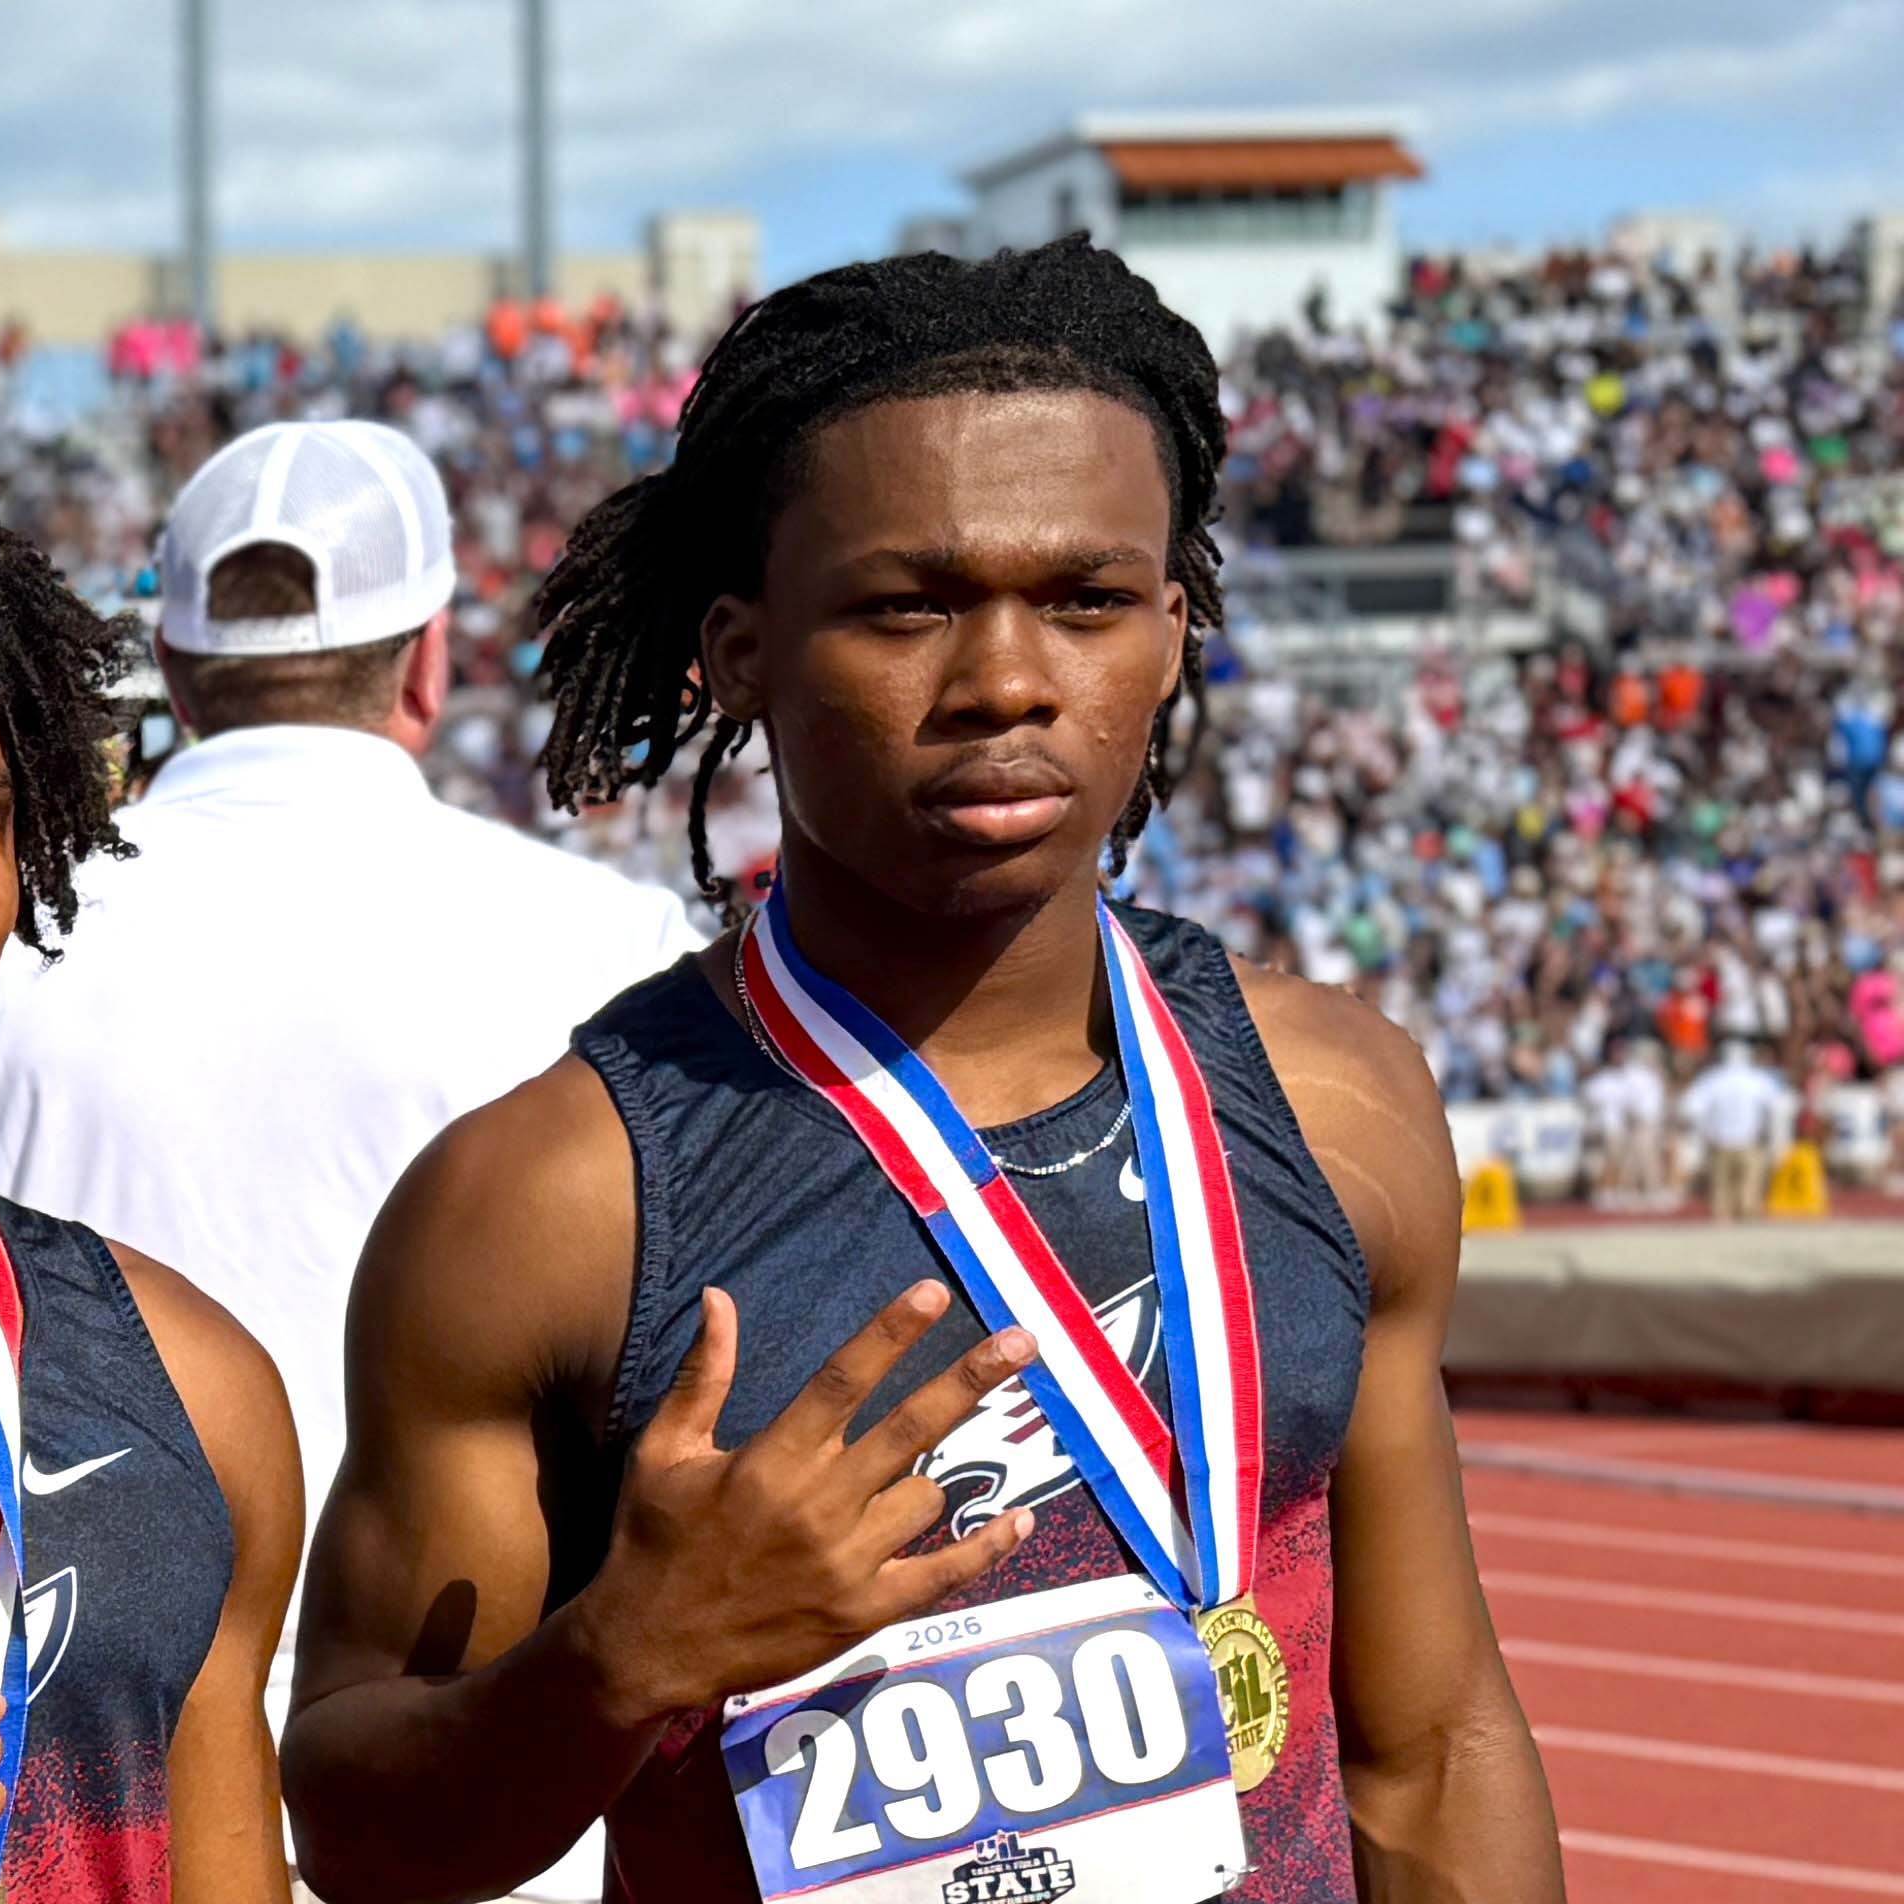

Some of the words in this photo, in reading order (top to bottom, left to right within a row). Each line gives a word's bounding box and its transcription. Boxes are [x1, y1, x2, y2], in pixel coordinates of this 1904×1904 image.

[905, 1615, 982, 1653] 2026
[763, 1629, 1188, 1870] 2930
[945, 1861, 1073, 1904] STATE
